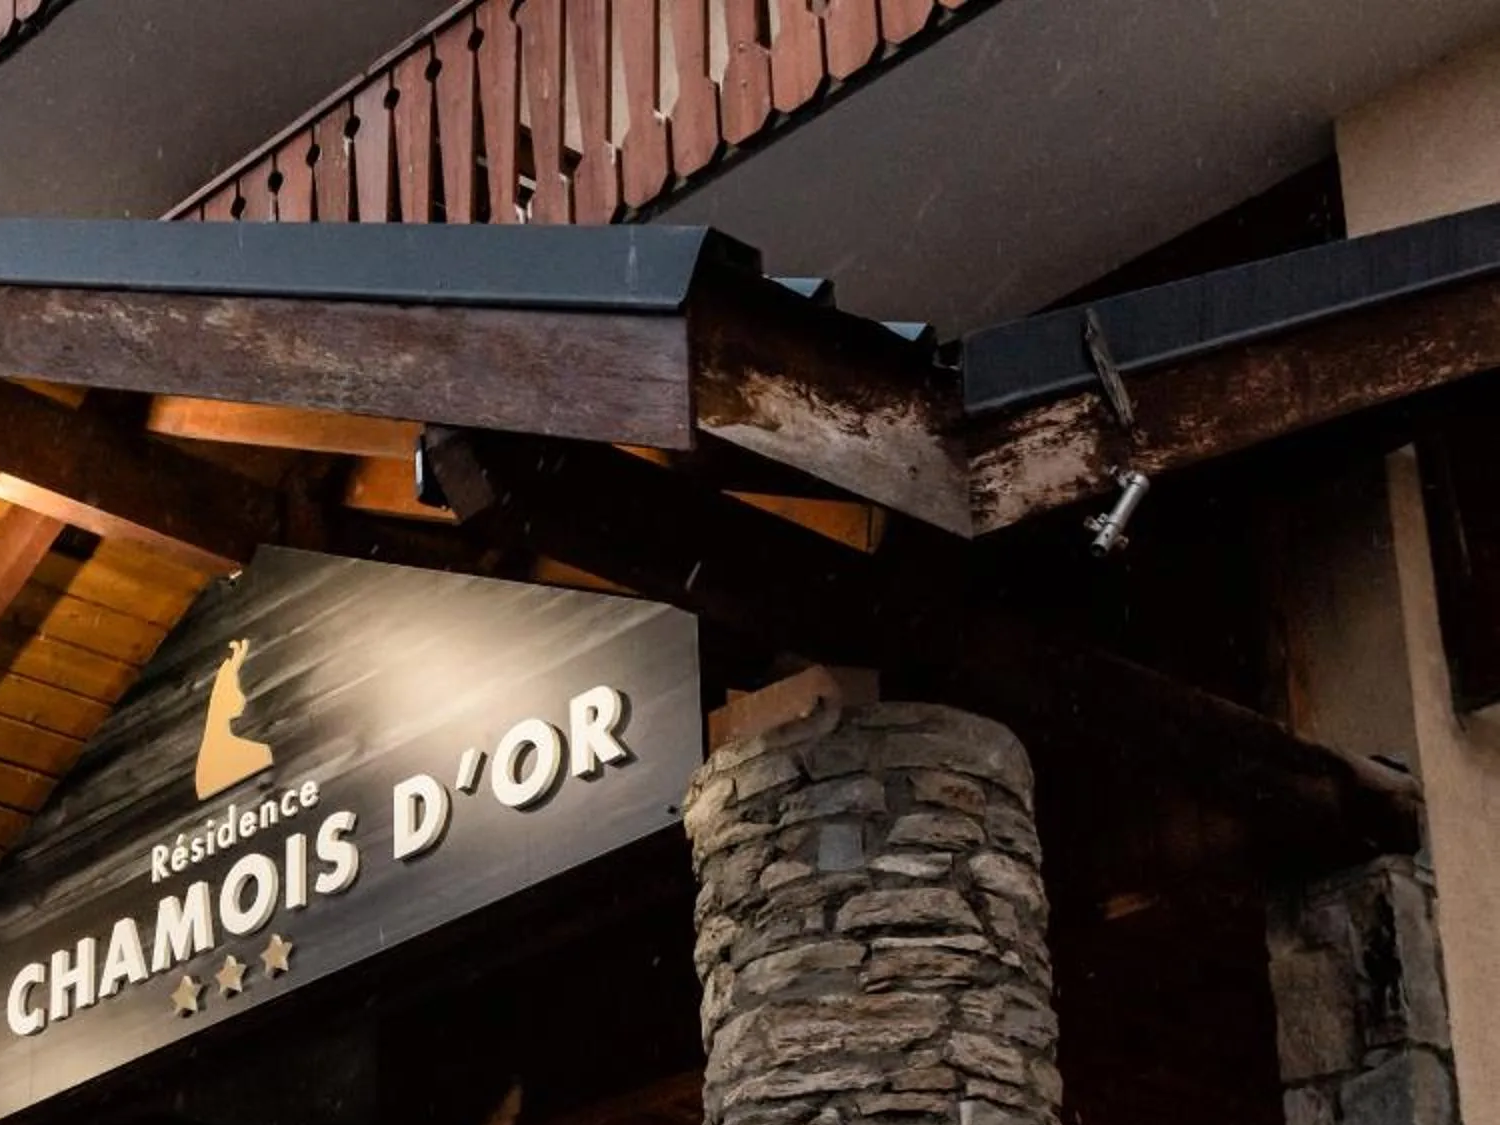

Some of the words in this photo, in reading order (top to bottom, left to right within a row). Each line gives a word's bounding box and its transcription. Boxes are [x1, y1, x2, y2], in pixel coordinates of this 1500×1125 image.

[7, 810, 359, 1037] CHAMOIS
[393, 685, 630, 859] D'OR
[151, 777, 320, 883] Résidence
